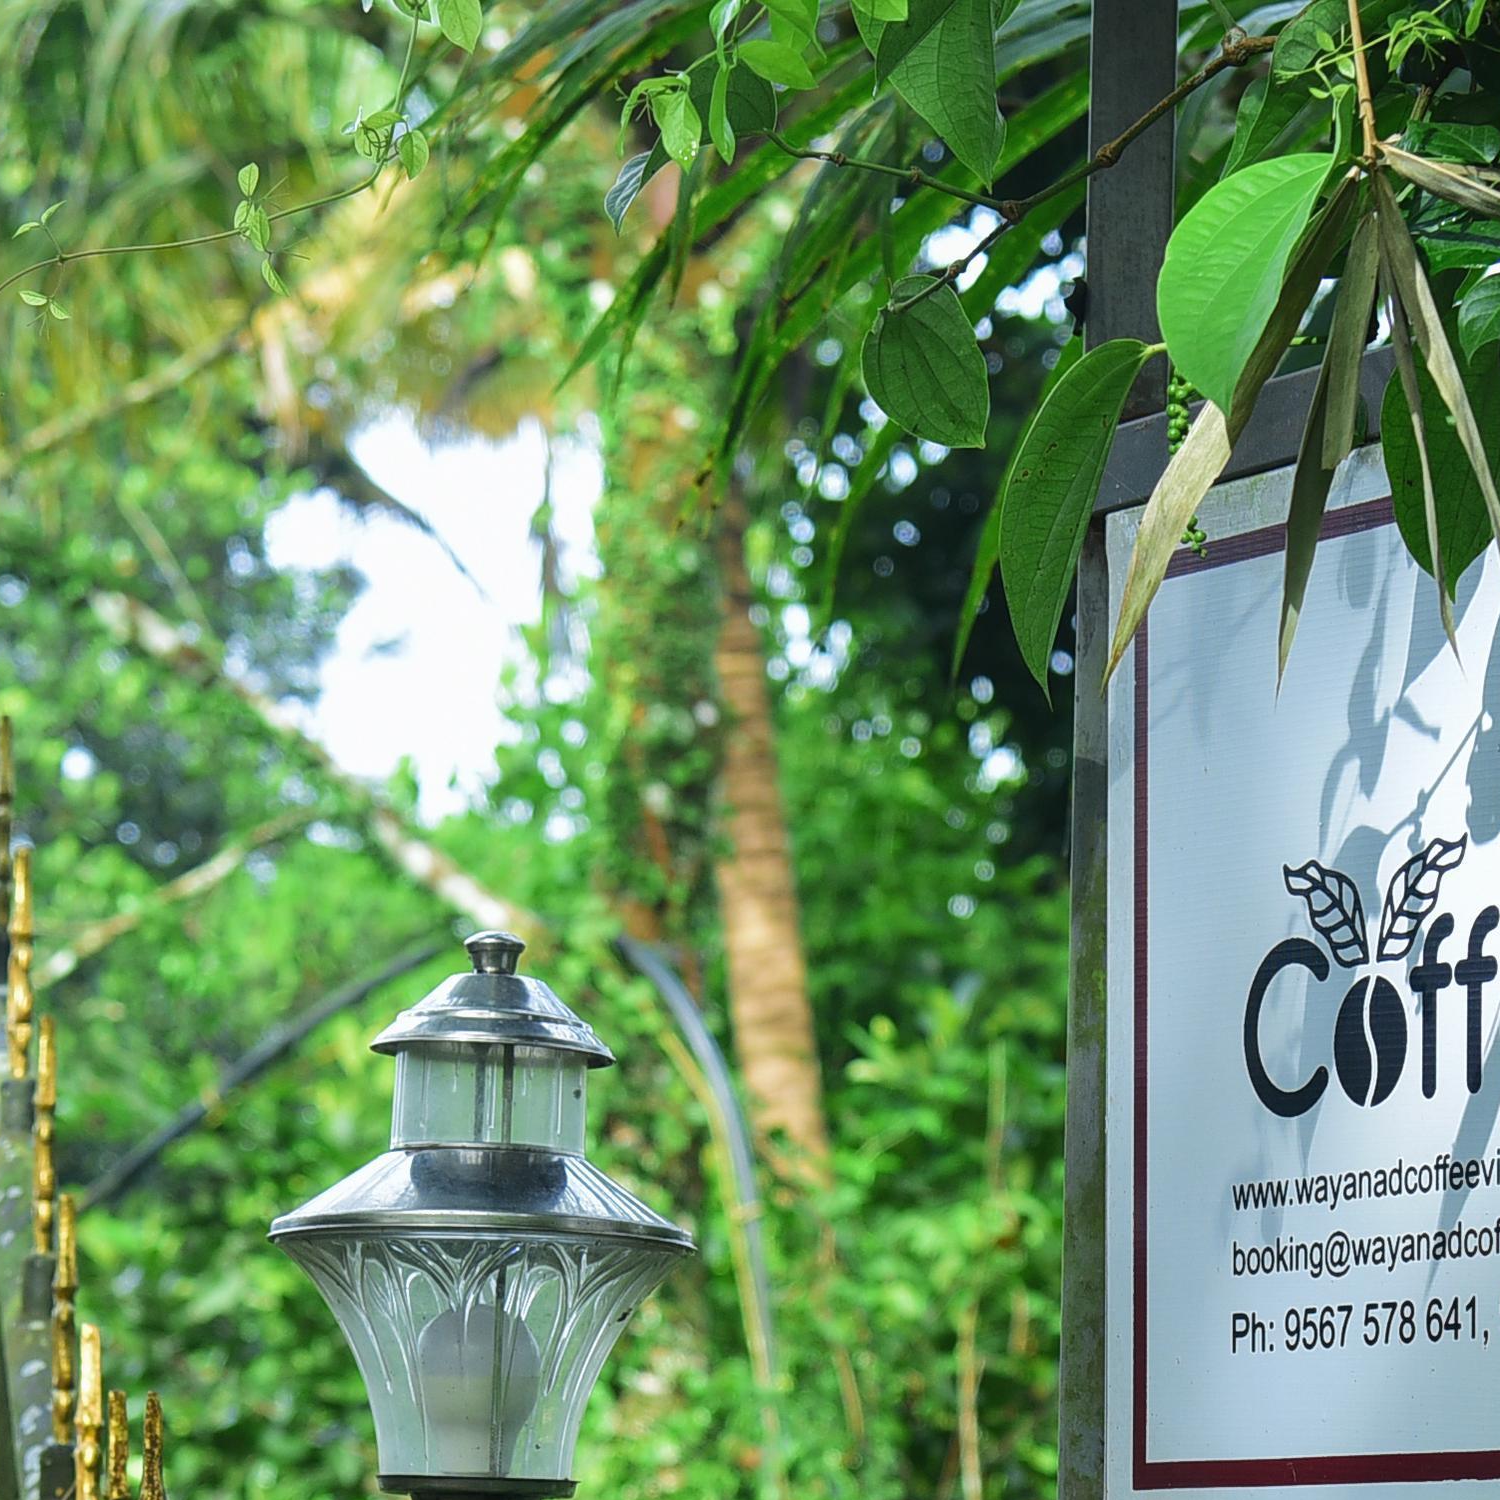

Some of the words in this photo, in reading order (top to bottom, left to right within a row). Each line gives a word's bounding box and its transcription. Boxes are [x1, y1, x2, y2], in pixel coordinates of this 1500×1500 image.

[1231, 1311, 1276, 1355] Ph:
[1284, 1304, 1354, 1352] 9567
[1362, 1299, 1417, 1347] 578
[1425, 1294, 1490, 1346] 641,
